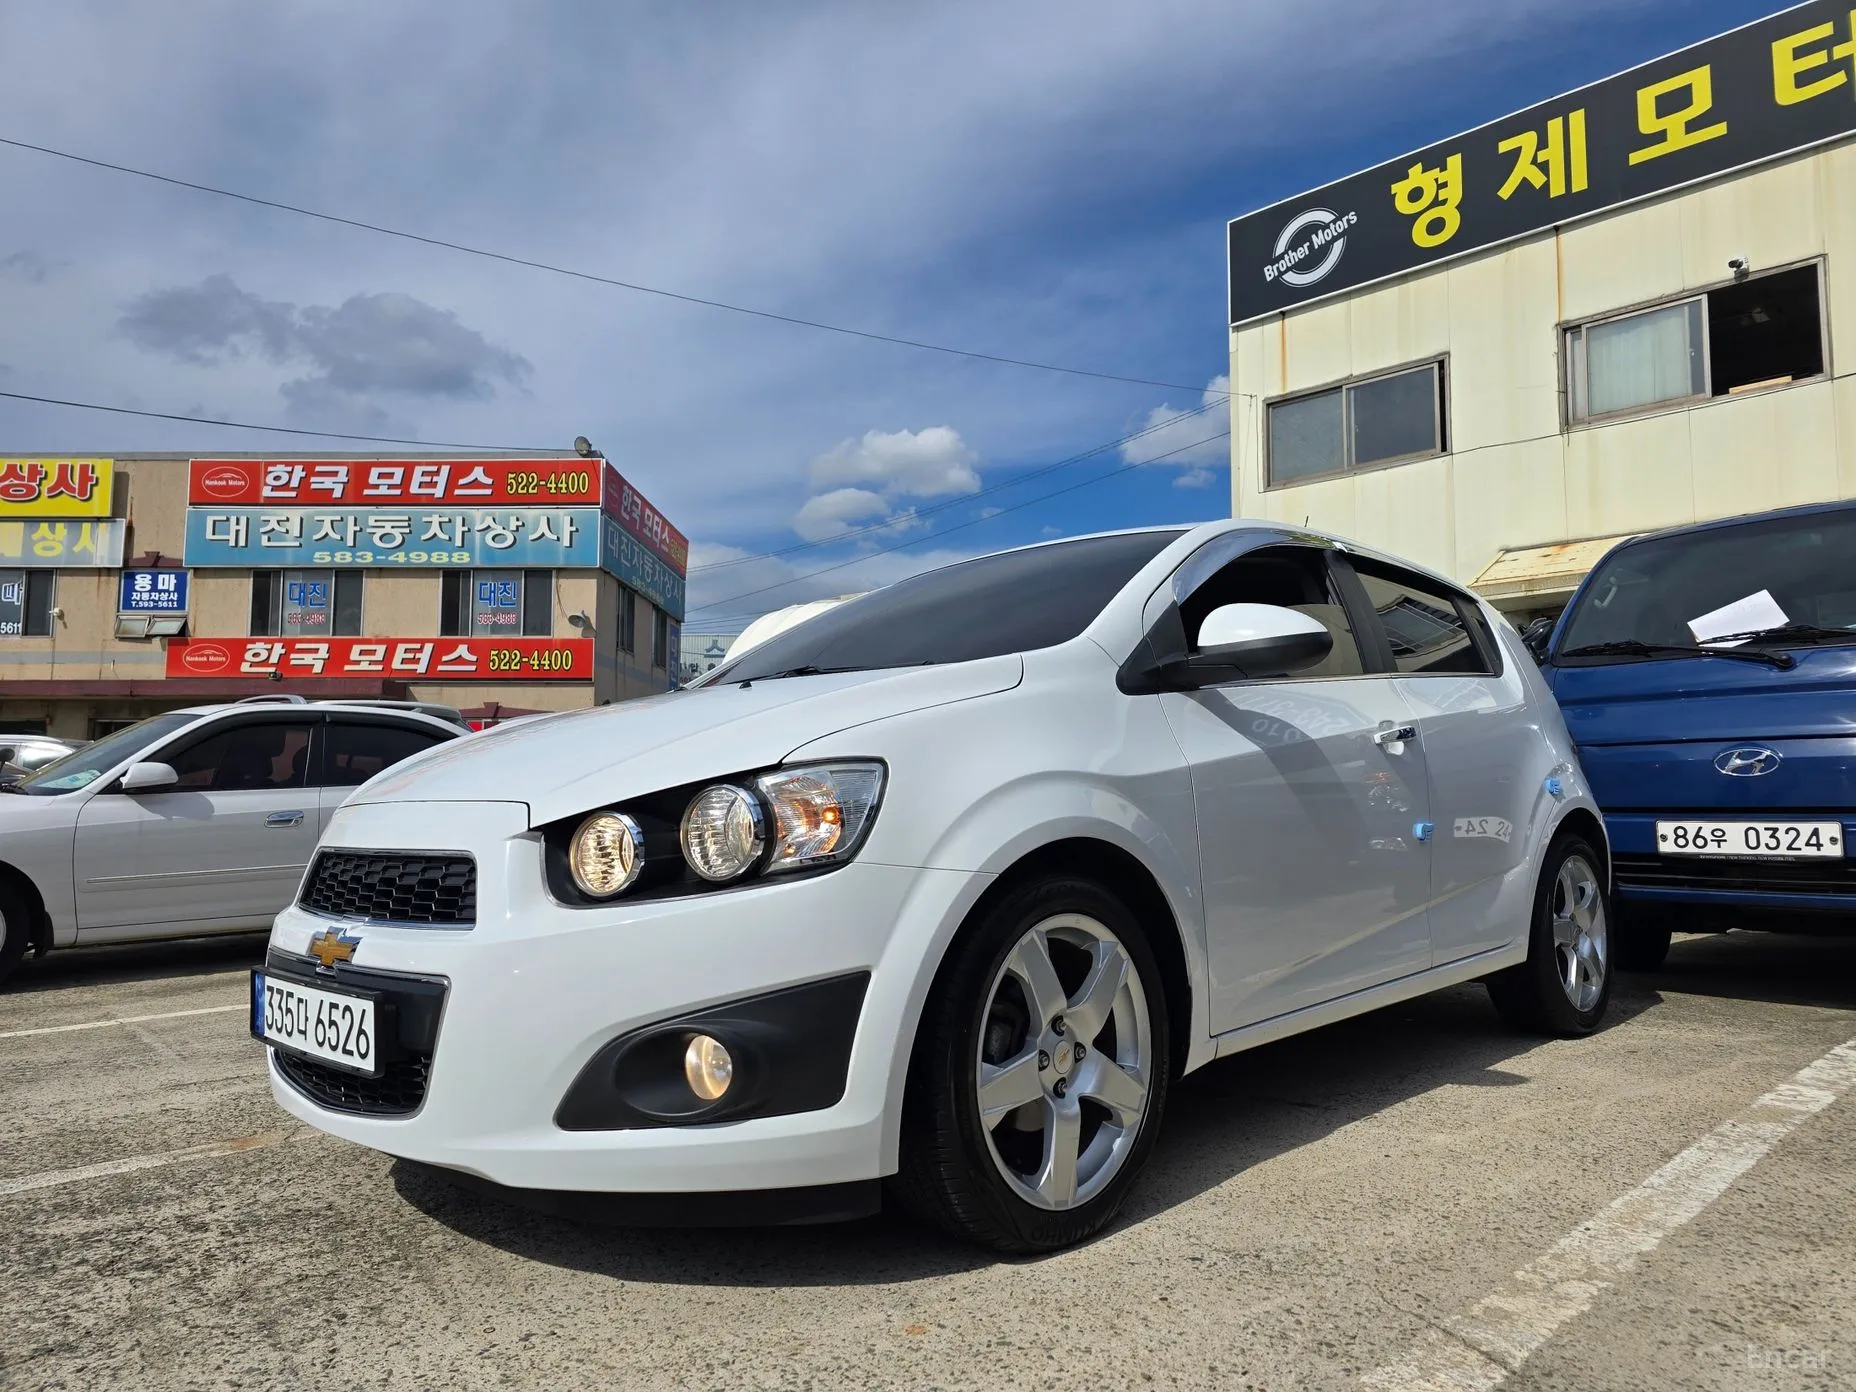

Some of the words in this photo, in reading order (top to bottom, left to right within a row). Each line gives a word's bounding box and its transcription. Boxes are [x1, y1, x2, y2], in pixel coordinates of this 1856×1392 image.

[1264, 242, 1310, 281] Brother
[1311, 211, 1358, 249] Motors
[0, 462, 97, 501] 상사
[262, 464, 349, 498] 한국
[363, 464, 494, 498] 모터스
[507, 472, 589, 494] 522-4400
[621, 484, 642, 530] 한국
[643, 507, 670, 553] 모터스
[313, 551, 470, 563] 583-4988
[131, 592, 178, 601] 자동차상사
[288, 582, 328, 608] 대진
[478, 581, 518, 608] 대진
[240, 642, 329, 674] 한국
[344, 642, 478, 674] 모터스
[489, 649, 572, 671] 522-4400
[1673, 826, 1727, 849] 86우
[1744, 827, 1824, 852] 0324
[266, 984, 309, 1041] 335다
[315, 999, 370, 1060] 6526
